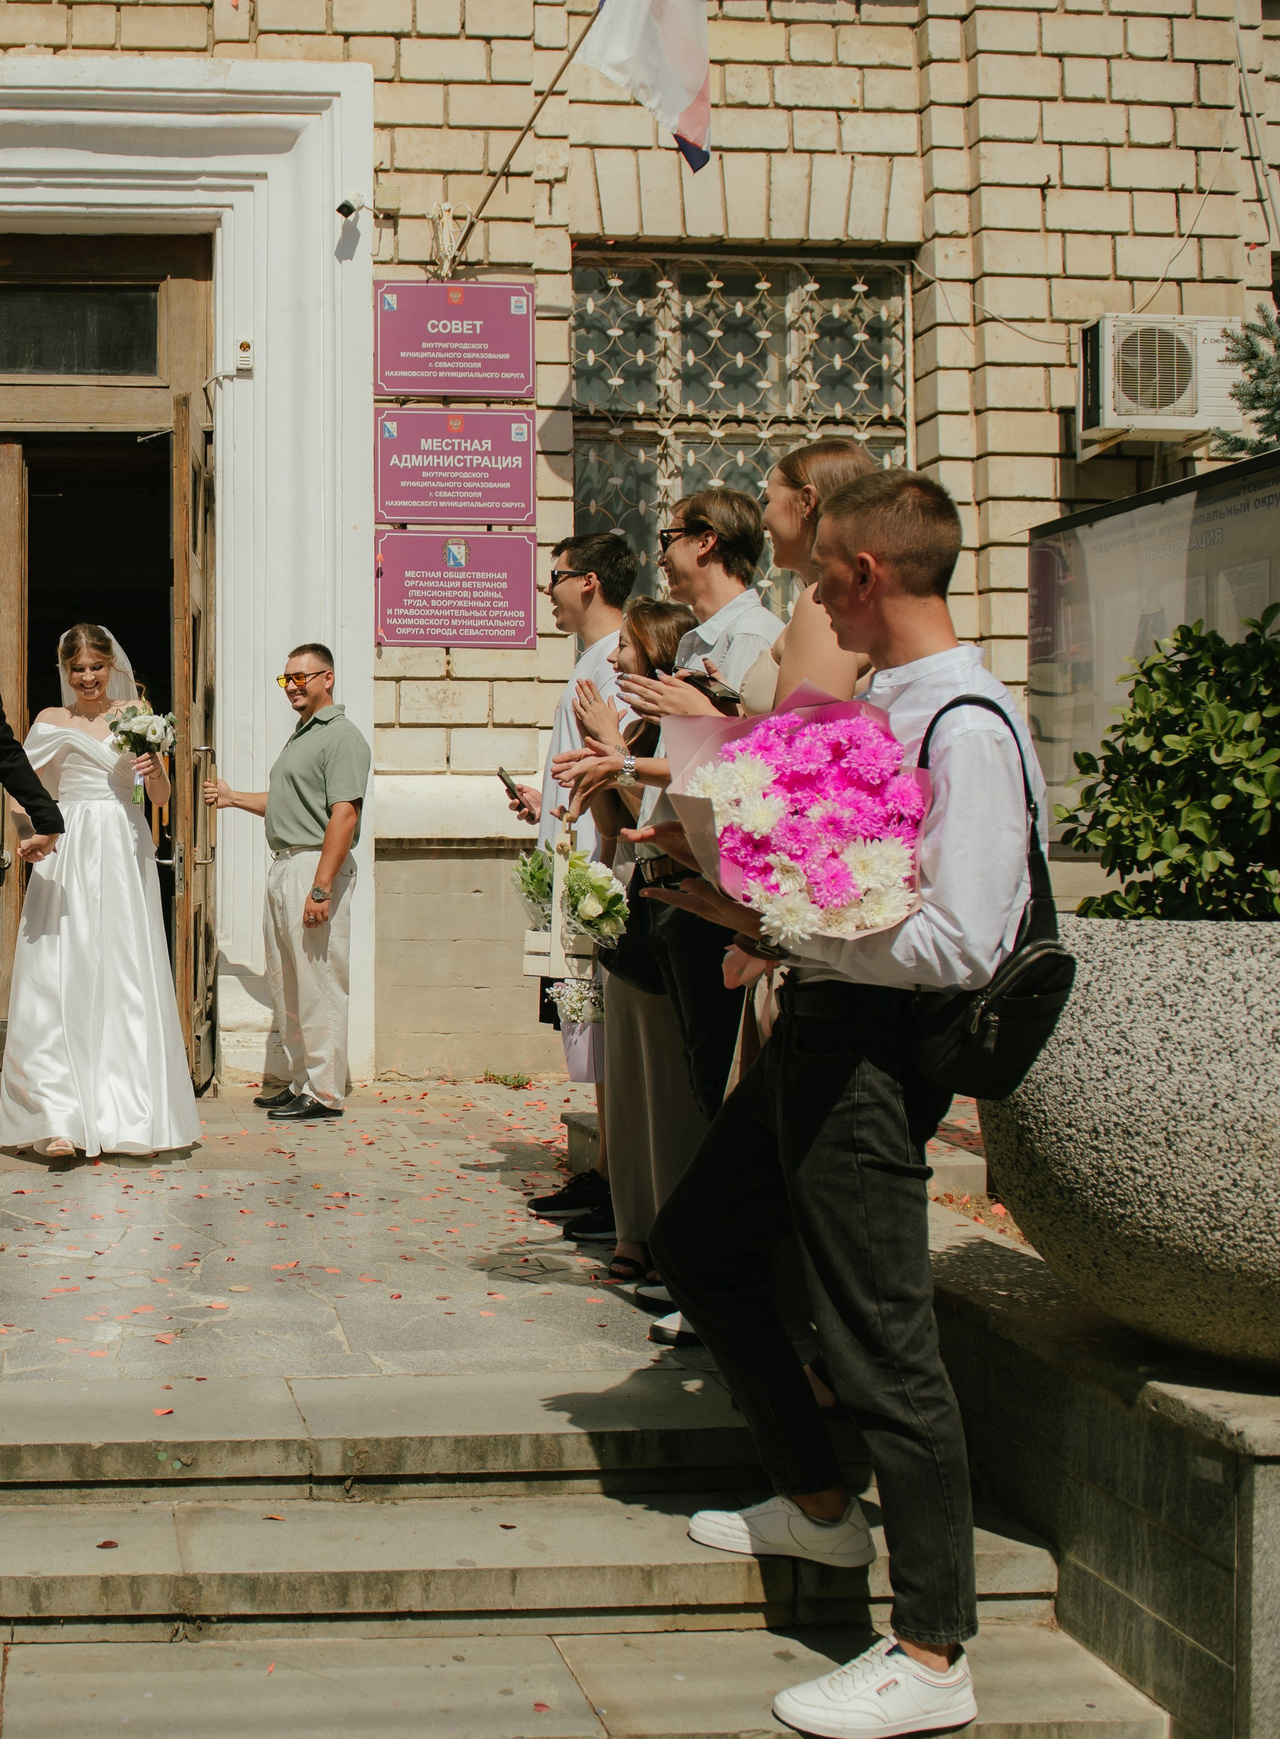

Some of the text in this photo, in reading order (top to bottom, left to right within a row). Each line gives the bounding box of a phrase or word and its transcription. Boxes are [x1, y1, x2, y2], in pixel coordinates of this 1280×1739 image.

[428, 320, 483, 334] СОВЕТ
[421, 439, 491, 451] МЕСТНАЯ
[390, 455, 522, 470] АДМИНИСТРАЦИЯ
[409, 590, 503, 598] (ПЕНСИОНЕРОВ) ВОЙНЫ,
[403, 599, 429, 607] ТРУДА,
[395, 609, 486, 617] ПРАВООХРАНИТЕЛЬНЫХ
[452, 619, 524, 627] МУНИЦИПАЛЬНОГО
